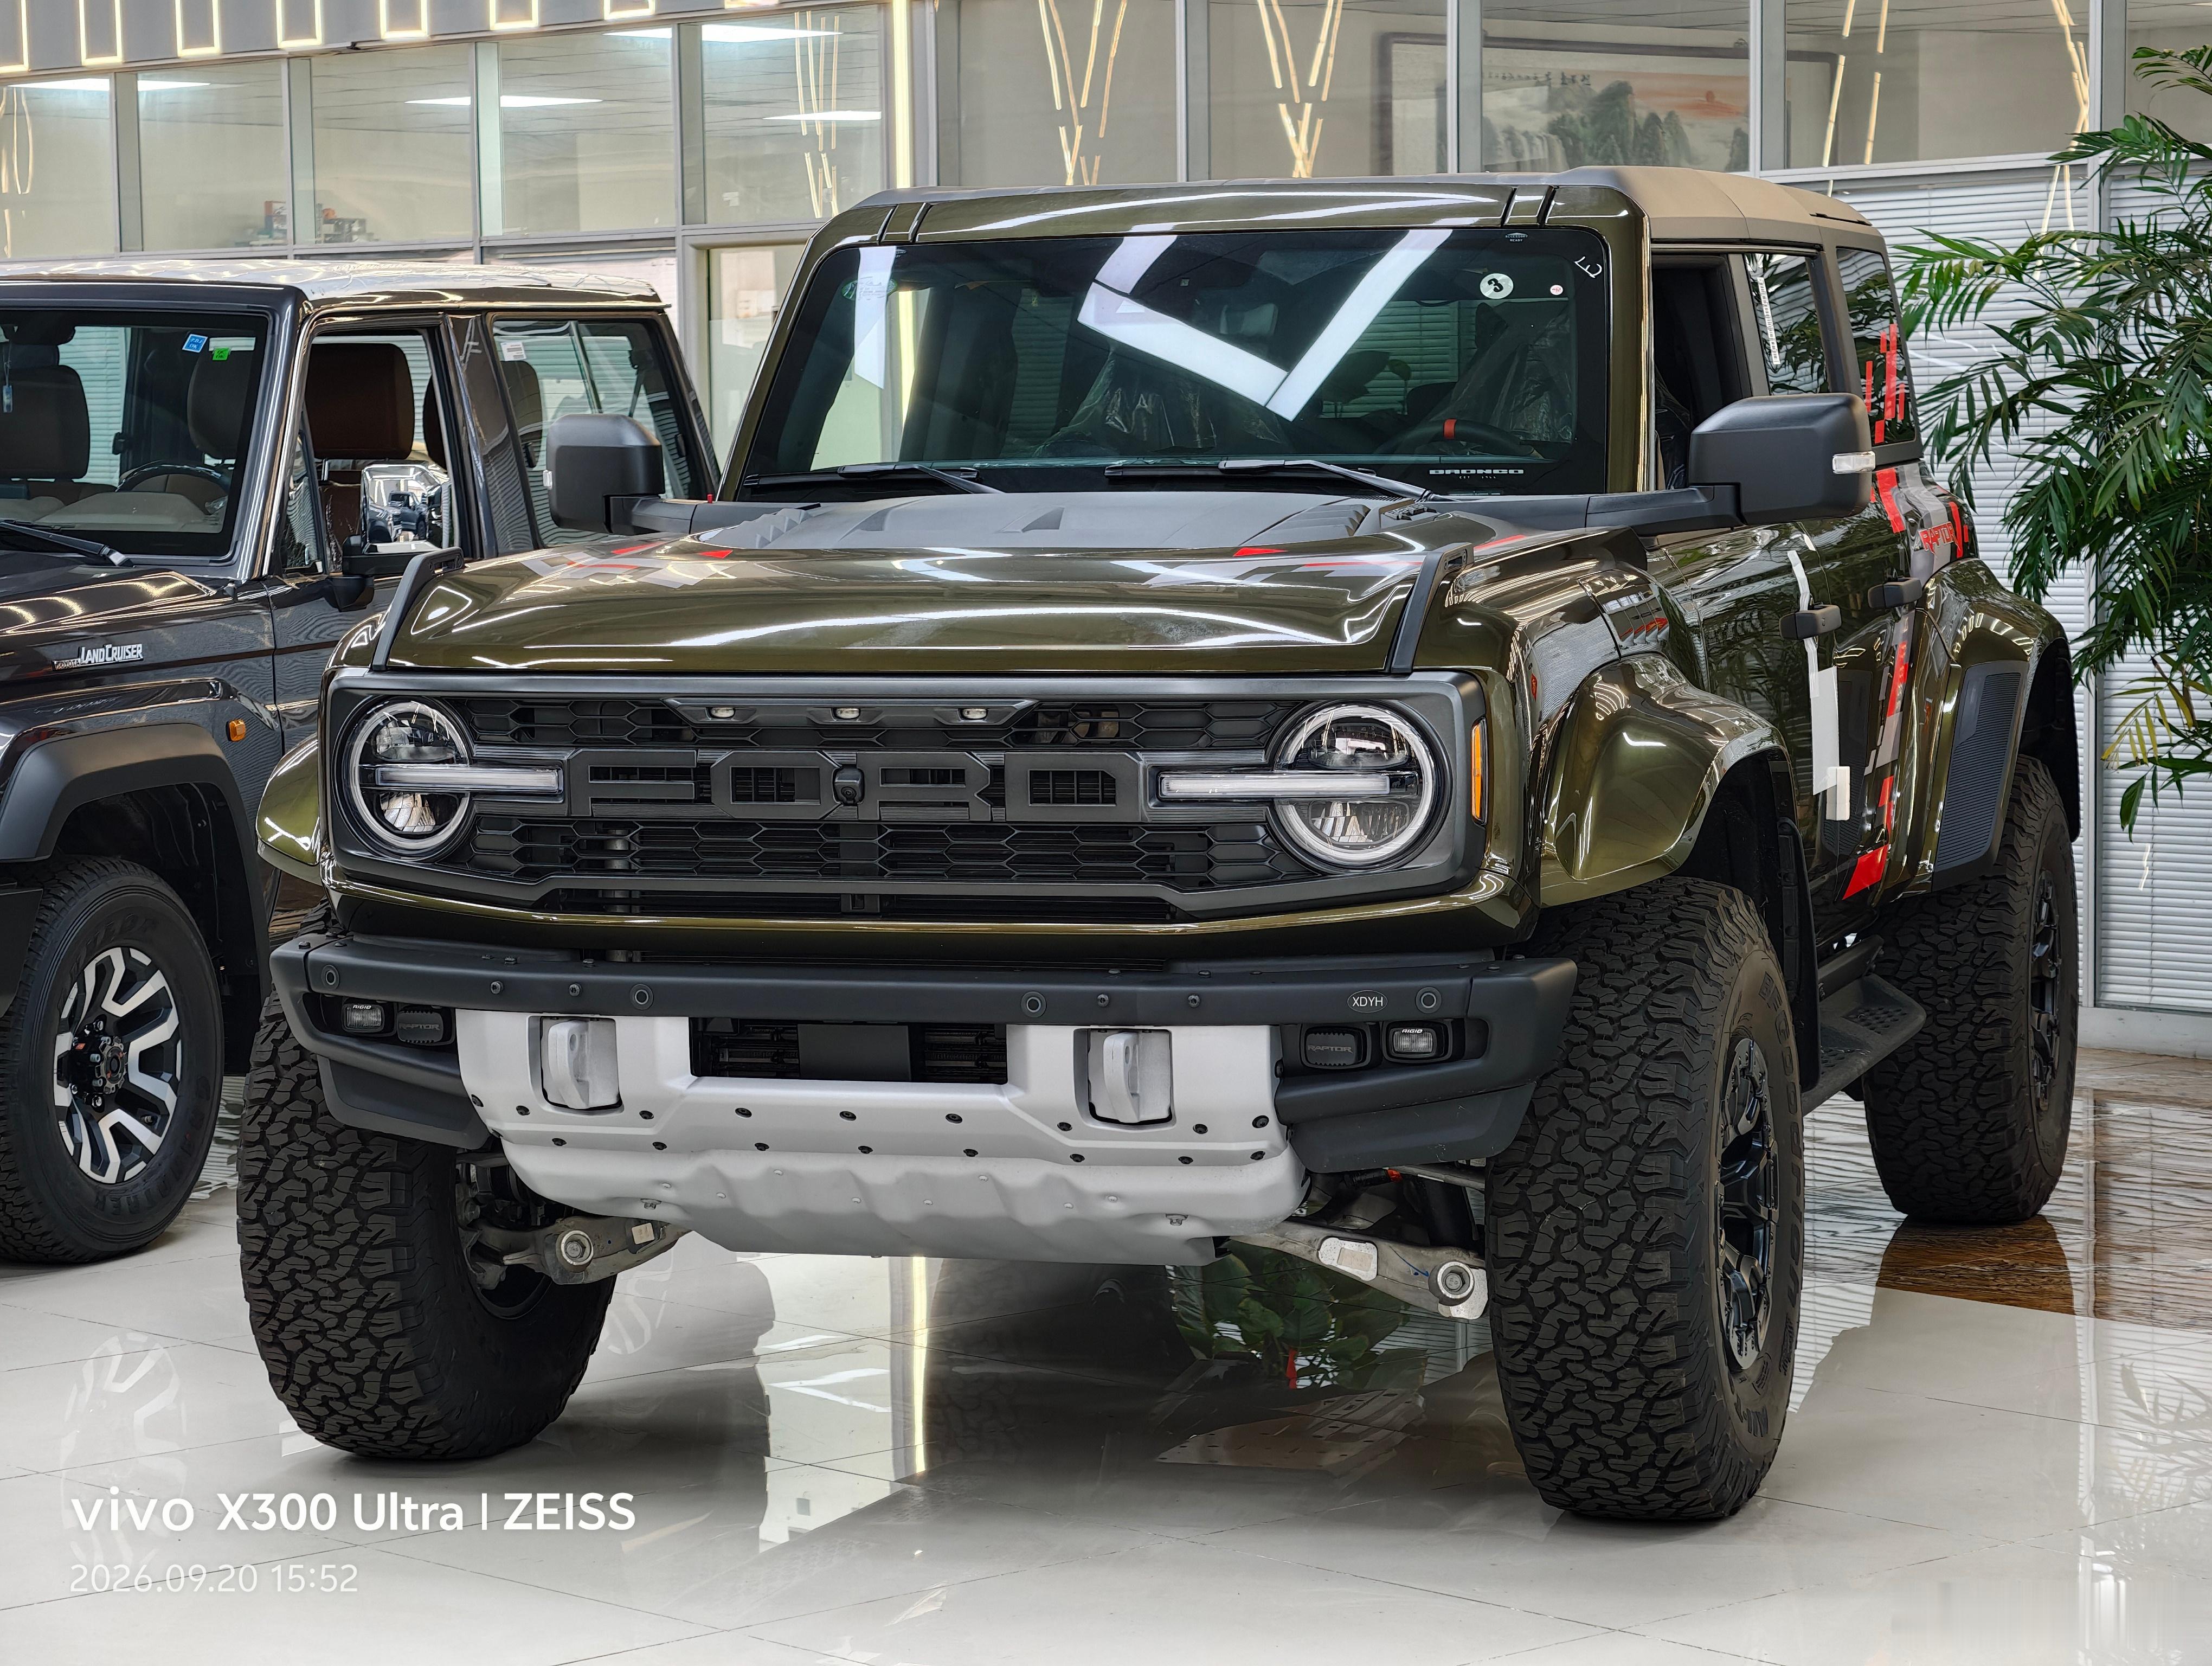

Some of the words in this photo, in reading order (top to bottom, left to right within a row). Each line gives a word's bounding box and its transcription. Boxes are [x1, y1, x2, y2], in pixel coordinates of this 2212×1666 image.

[1487, 278, 1504, 293] 3
[1919, 522, 1960, 554] RAPTOR
[55, 658, 81, 670] TOYOTA
[569, 750, 1142, 823] FORD
[1352, 996, 1383, 1007] XDYH
[398, 1023, 441, 1031] RAPTOR
[1307, 1045, 1354, 1053] RAPTOR
